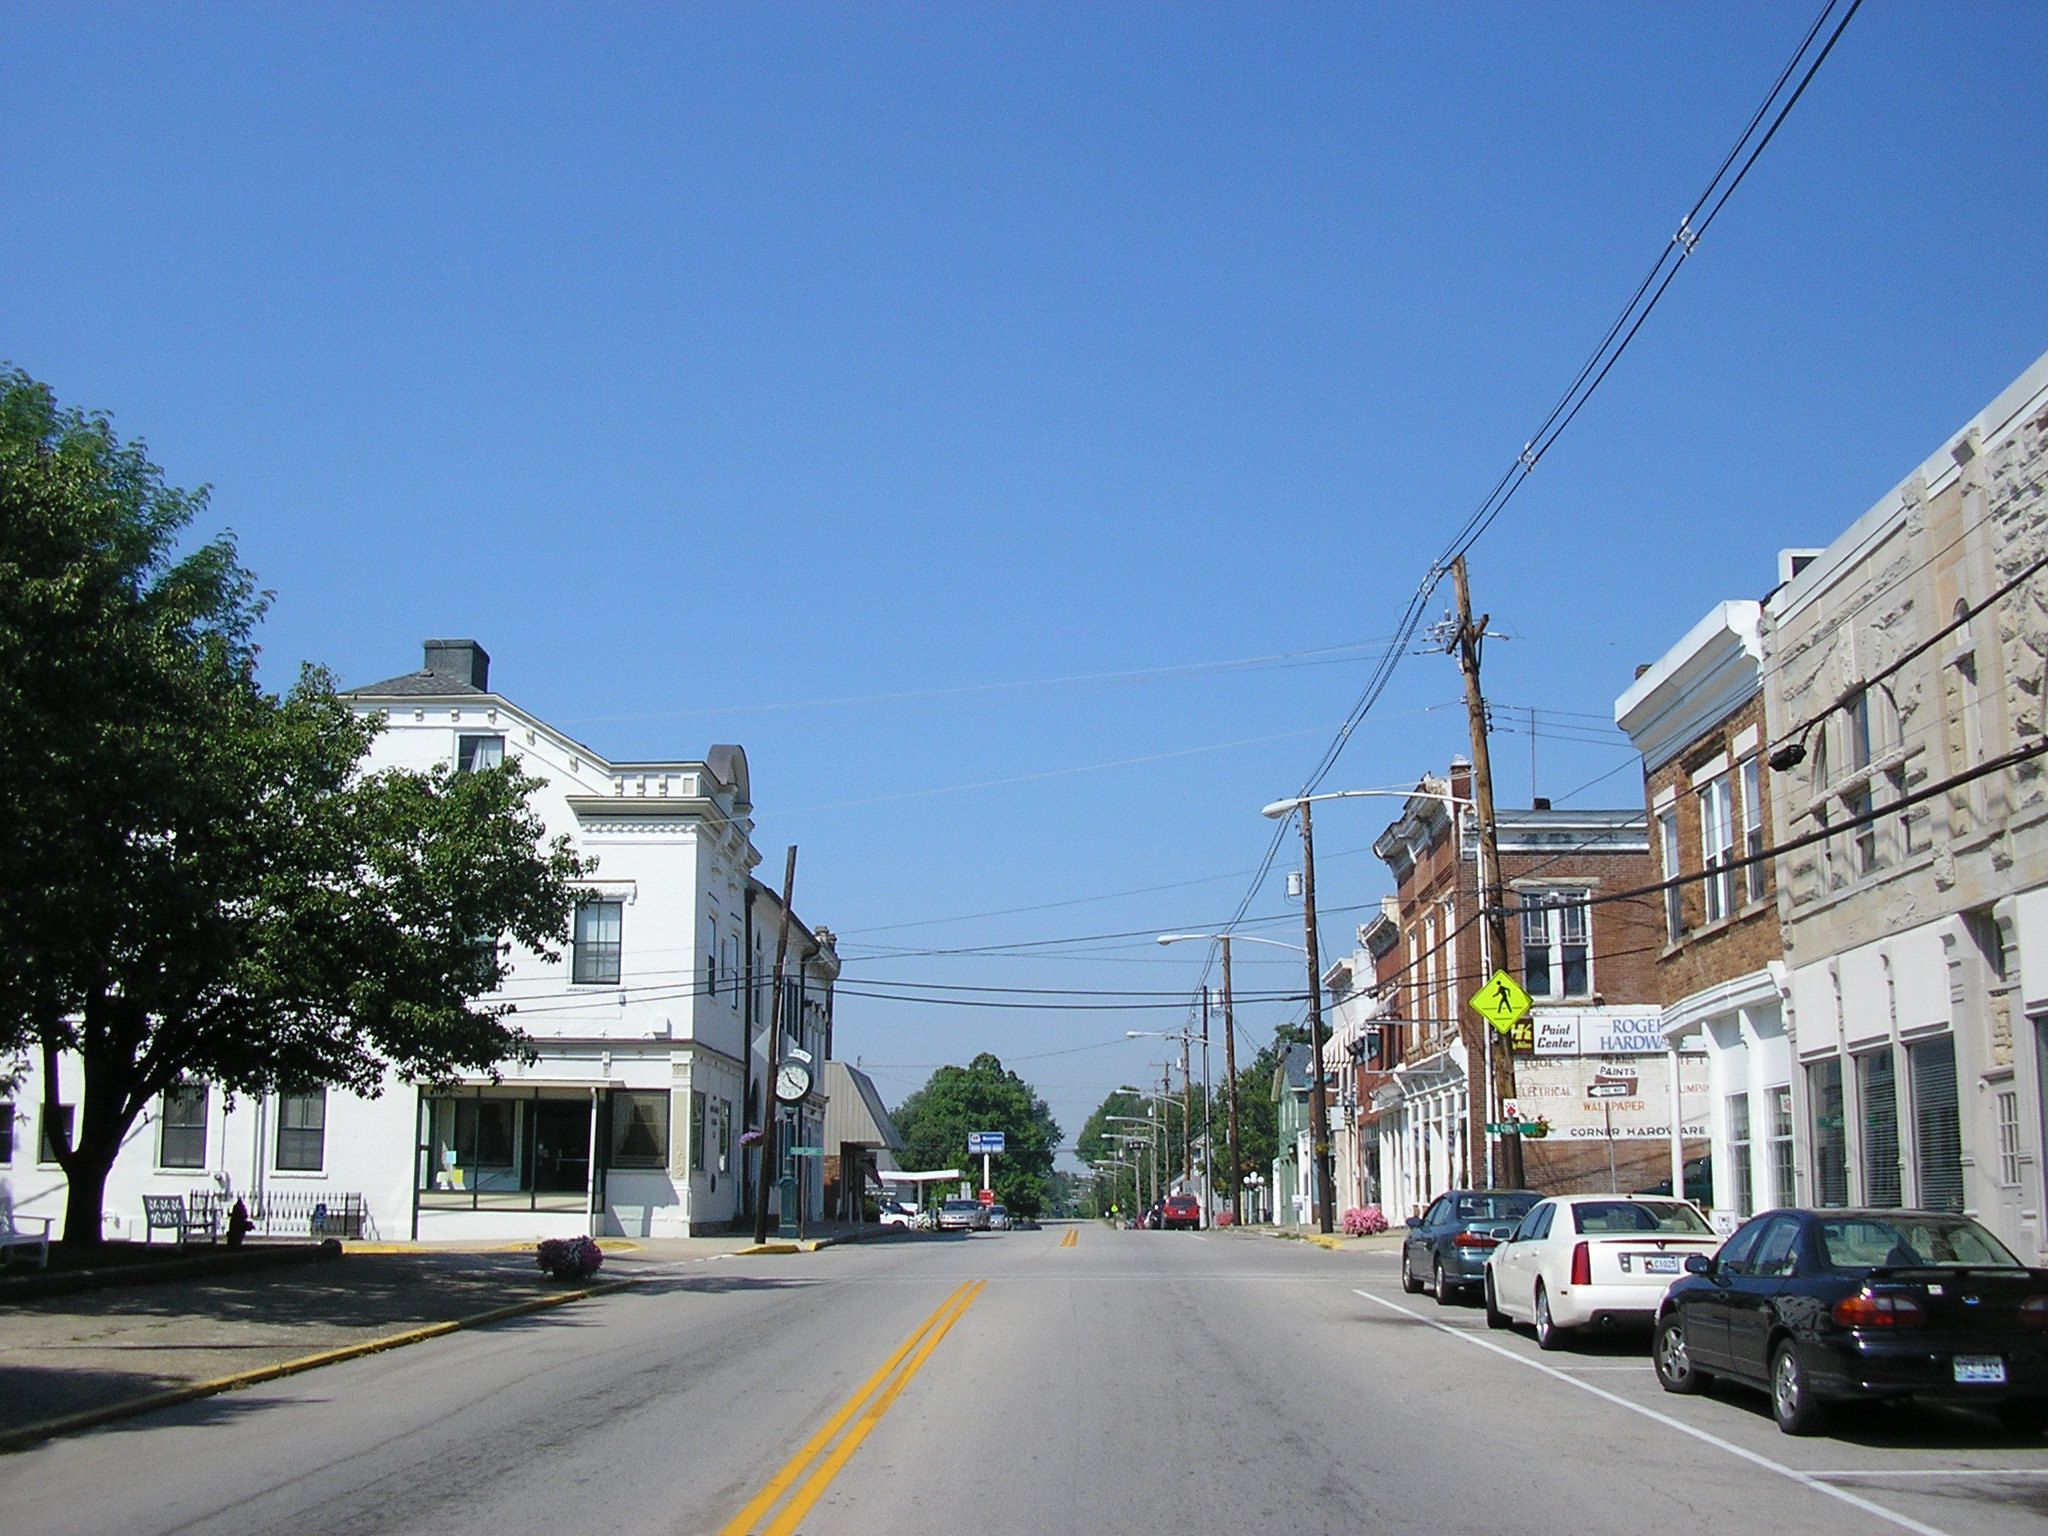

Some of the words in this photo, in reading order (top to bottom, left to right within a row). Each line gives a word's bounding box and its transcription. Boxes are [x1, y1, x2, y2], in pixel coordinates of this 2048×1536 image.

[1541, 1024, 1571, 1035] Paint
[1537, 1037, 1576, 1049] Center
[1600, 1066, 1636, 1077] PAINTS
[1570, 1127, 1620, 1137] CORNER
